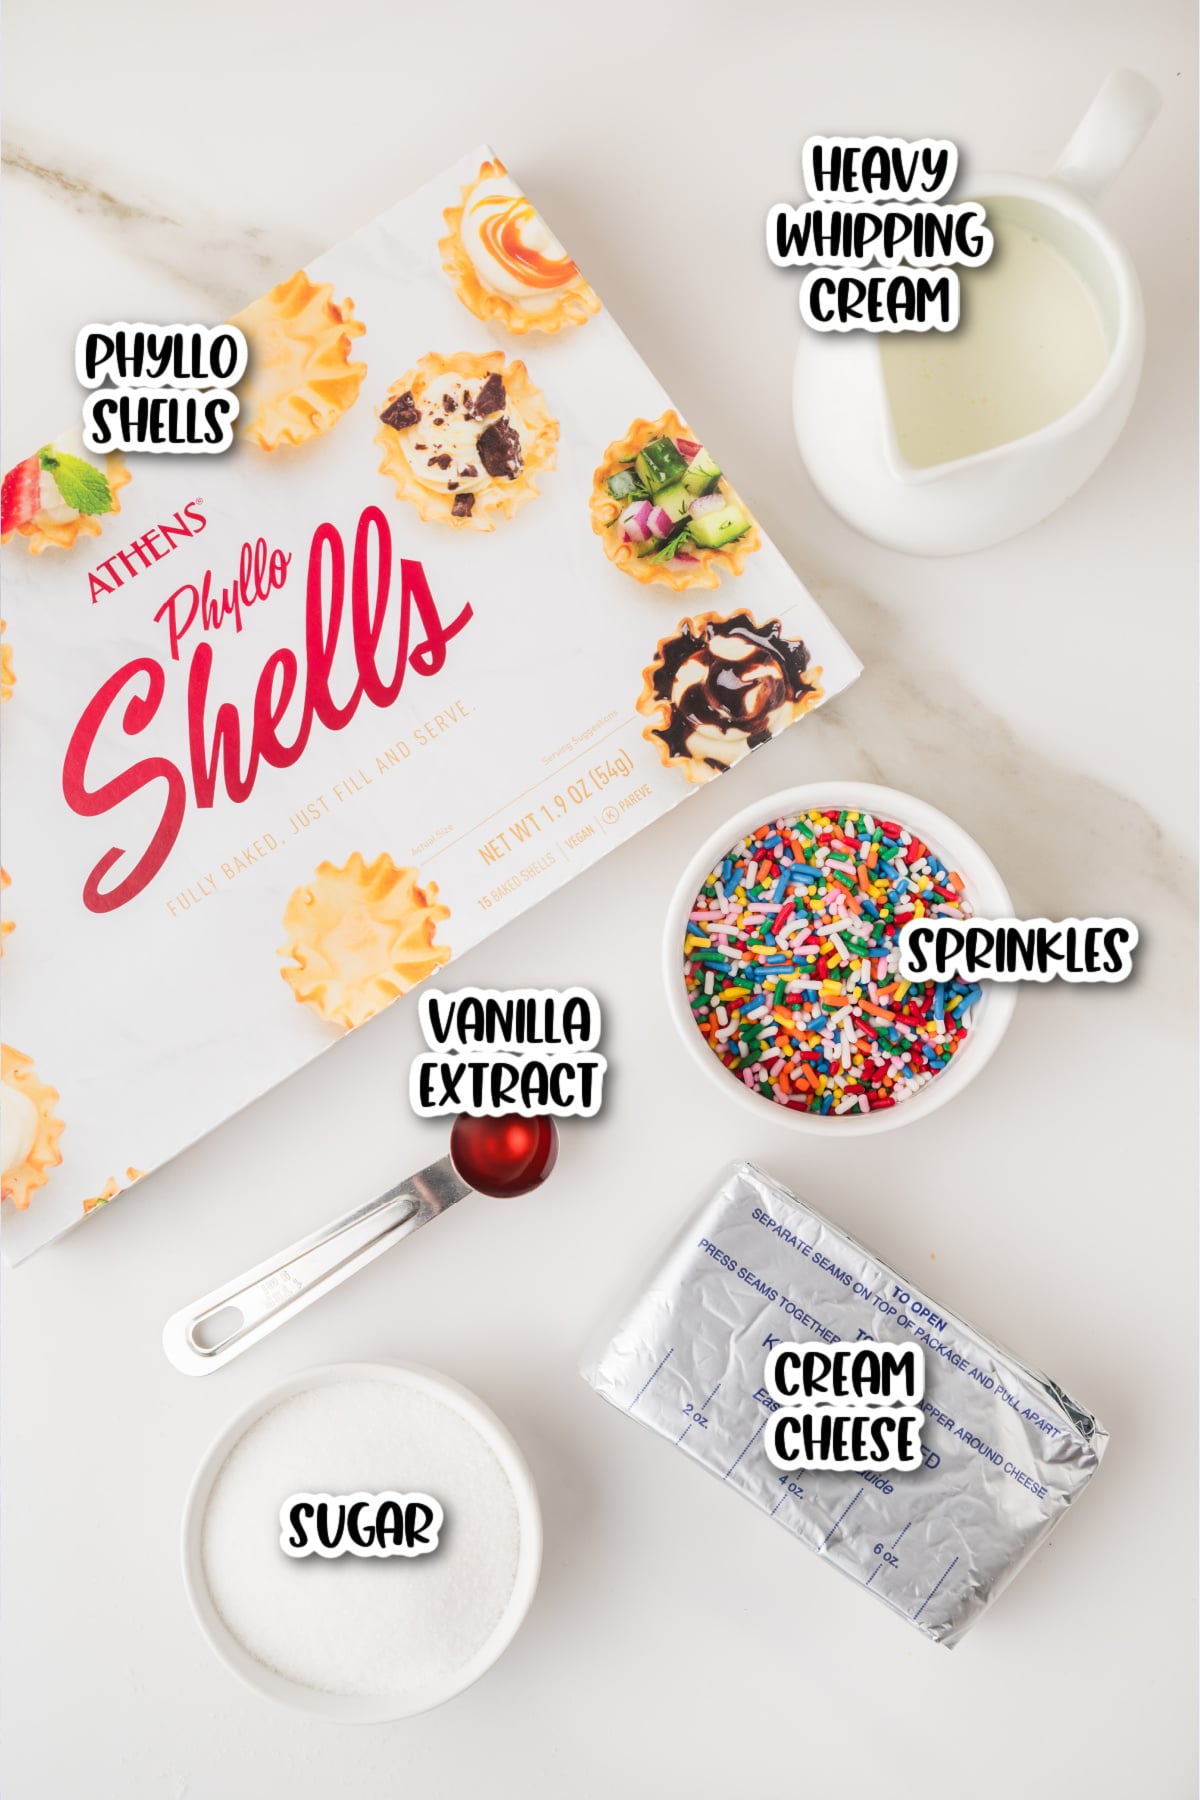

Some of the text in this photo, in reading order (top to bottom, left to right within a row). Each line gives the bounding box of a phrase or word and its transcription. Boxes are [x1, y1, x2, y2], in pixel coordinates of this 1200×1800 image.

[153, 537, 292, 661] Phyllo
[62, 505, 474, 914] Shells
[541, 710, 619, 765] Serving Suggestions
[166, 874, 217, 918] FULLY
[289, 796, 332, 836] JUST
[332, 768, 373, 803] FILL
[376, 741, 411, 775] AND
[414, 699, 477, 747] SERVE.
[477, 893, 492, 911] 15
[490, 875, 521, 901] BAKED
[520, 852, 556, 882] SHELLS
[564, 824, 596, 850] VEGAN
[618, 783, 653, 812] PAREVE
[478, 749, 635, 866] NET WT 1.9 OZ (54g)
[698, 1238, 738, 1272] PRESS
[736, 1267, 779, 1302] SEAMS
[953, 1426, 1004, 1467] AROUND
[1003, 1461, 1049, 1500] CHEESE
[751, 1207, 1062, 1439] SEPARATE SEAMS ON TOP OF PACKAGE AND PULL APART
[892, 1286, 948, 1333] TO OPEN
[682, 1403, 709, 1430] 2 oz.
[778, 1474, 804, 1499] 4 oz.
[873, 1543, 899, 1569] 6 oz.
